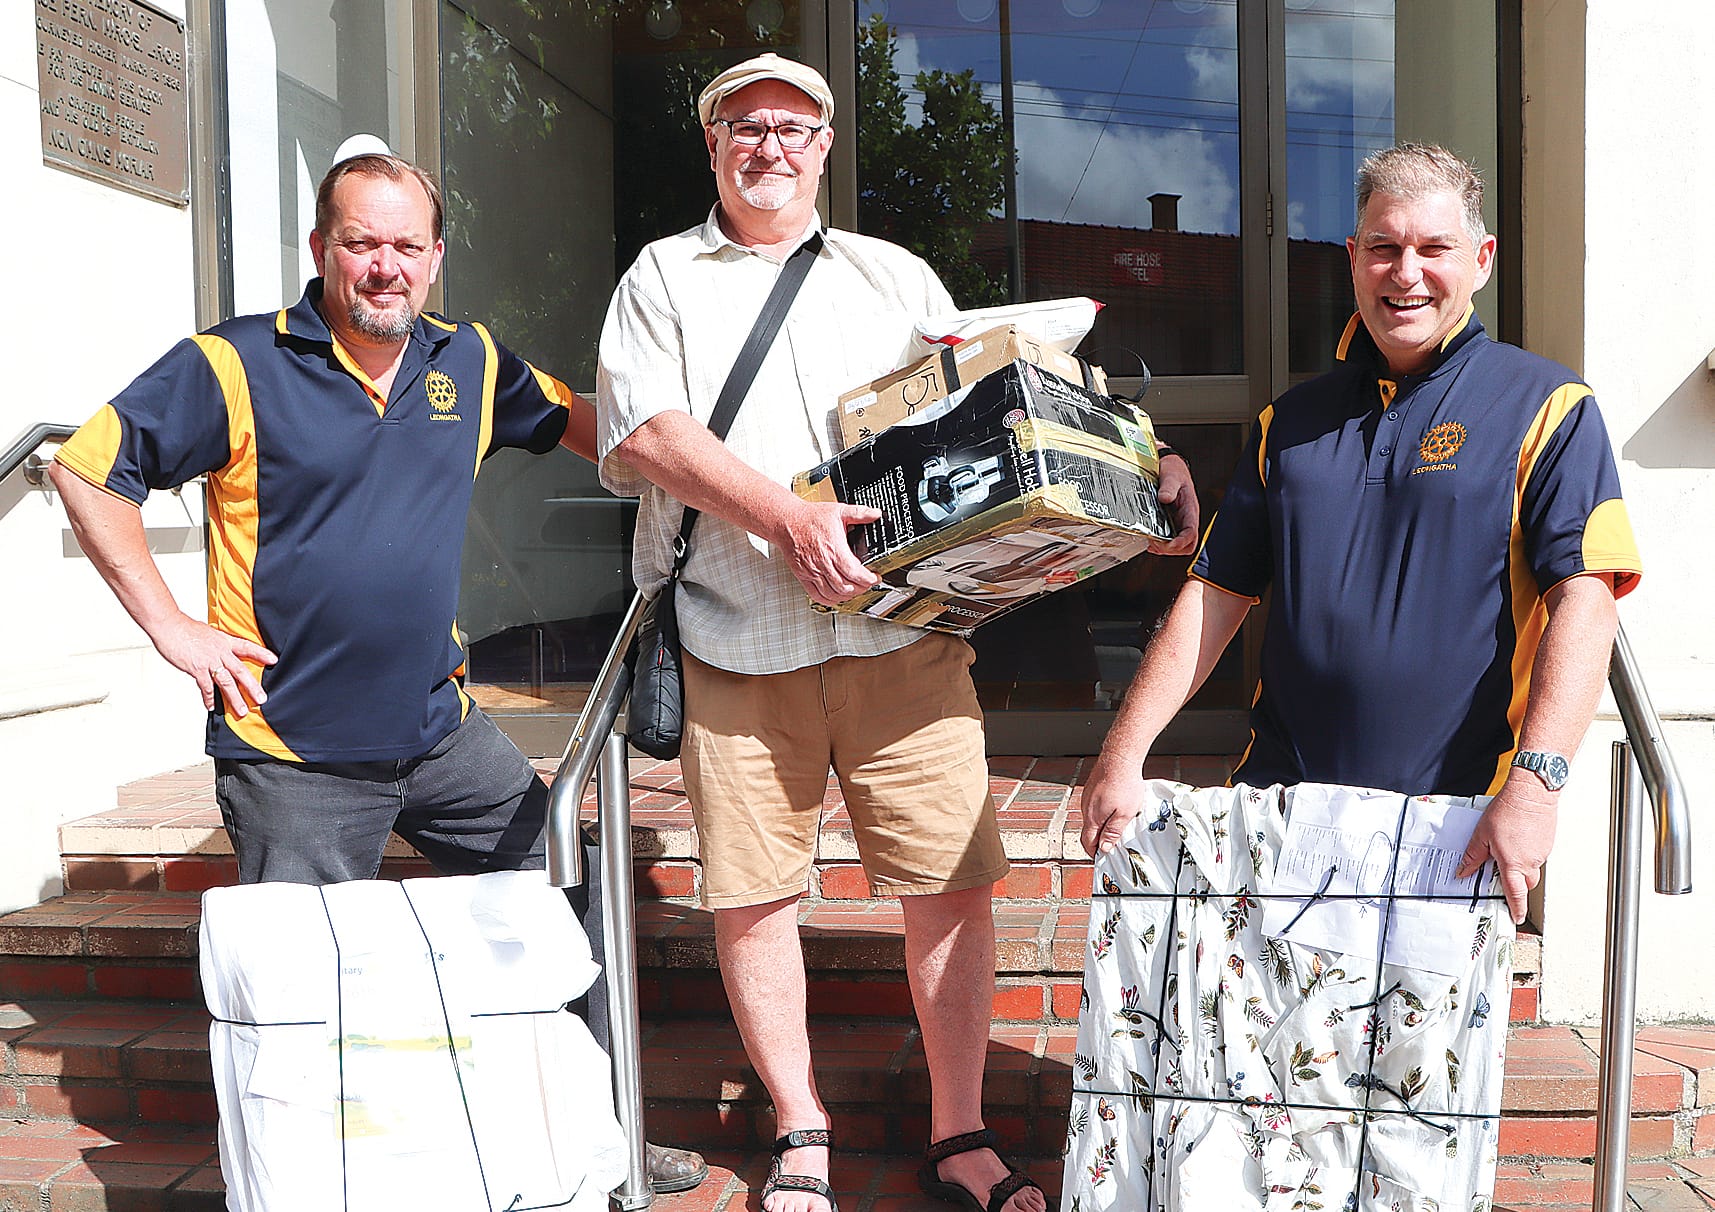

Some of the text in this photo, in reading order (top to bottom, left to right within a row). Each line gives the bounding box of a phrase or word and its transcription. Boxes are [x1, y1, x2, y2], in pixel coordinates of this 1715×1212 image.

[1113, 252, 1161, 267] FIRE HOSE
[894, 465, 916, 540] FOOD PROCESSO
